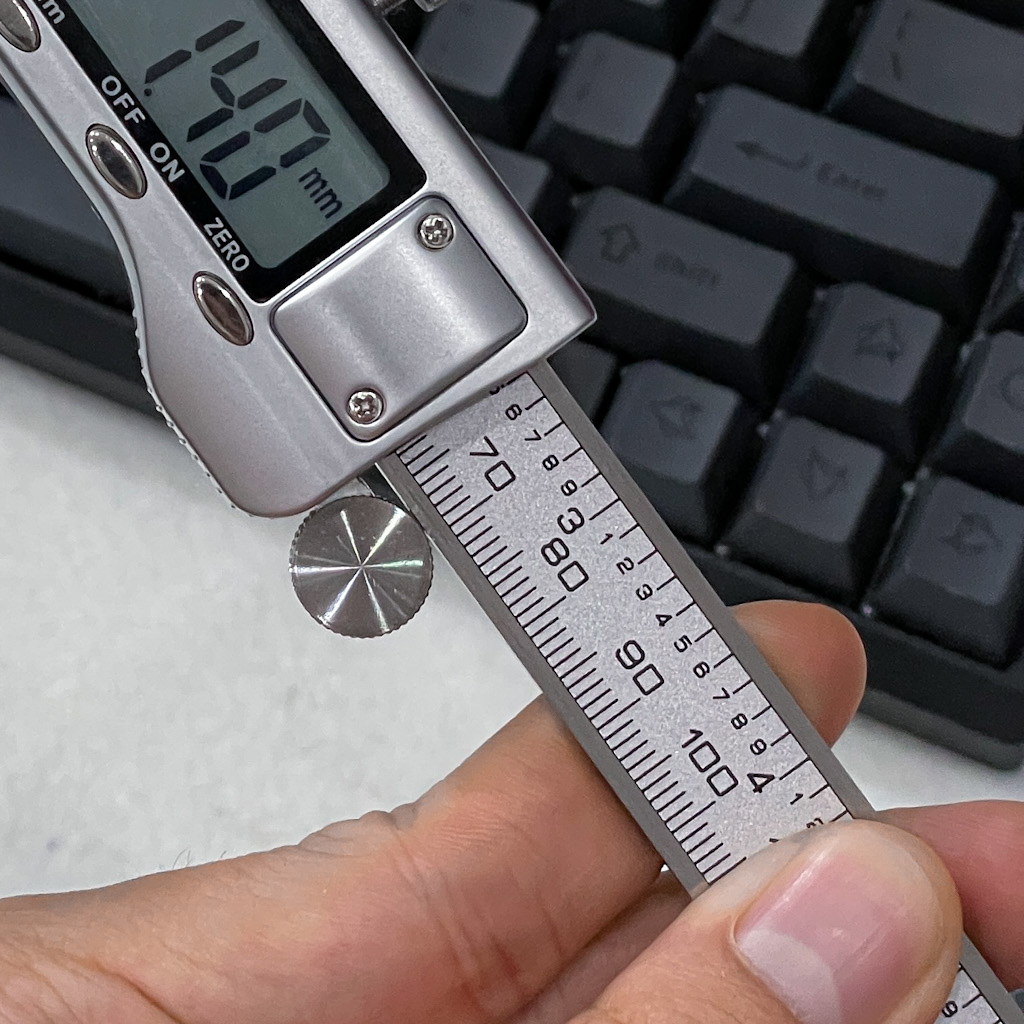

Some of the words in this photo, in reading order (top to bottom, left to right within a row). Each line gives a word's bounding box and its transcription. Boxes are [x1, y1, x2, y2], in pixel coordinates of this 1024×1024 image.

[144, 18, 332, 202] 1.40
[298, 167, 344, 220] mm
[100, 74, 147, 125] OFF
[149, 141, 186, 184] ON
[203, 216, 250, 273] ZERO
[524, 429, 542, 444] 7
[542, 454, 559, 471] 8
[560, 479, 578, 497] 9
[557, 507, 585, 535] 3
[599, 532, 614, 545] 1
[616, 557, 635, 576] 2
[635, 583, 654, 601] 3
[469, 435, 517, 492] 70
[540, 537, 590, 592] 80
[615, 639, 665, 696] 90
[681, 728, 739, 797] 100
[655, 613, 673, 628] 4
[673, 634, 693, 653] 5
[692, 661, 711, 679] 6
[712, 687, 731, 700] 7
[730, 713, 749, 730] 8
[749, 738, 768, 756] 9
[746, 772, 776, 794] 4
[789, 792, 804, 805] 1
